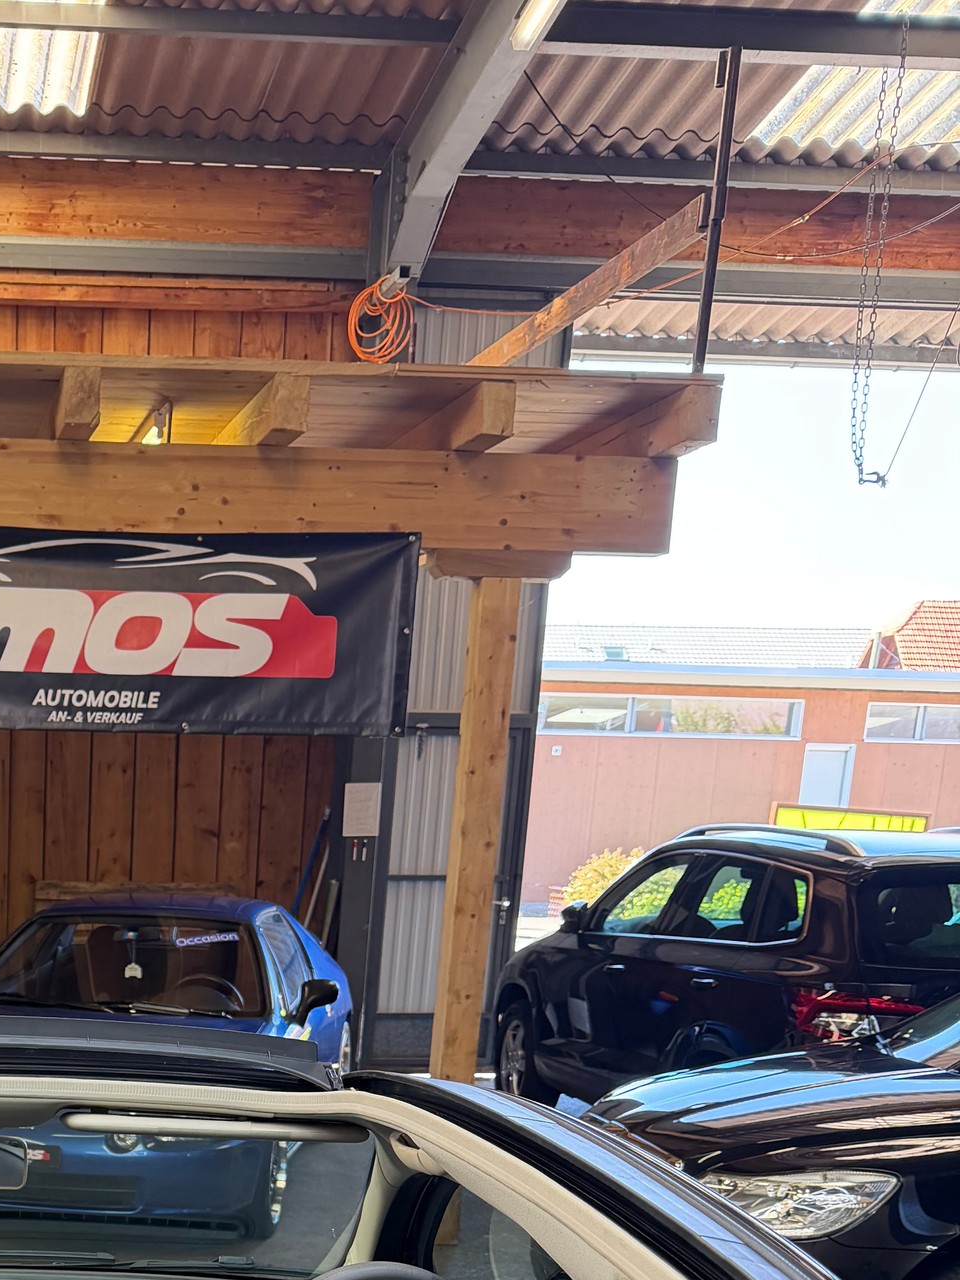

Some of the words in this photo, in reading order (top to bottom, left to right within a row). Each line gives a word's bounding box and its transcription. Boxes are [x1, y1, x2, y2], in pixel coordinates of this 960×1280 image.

[32, 688, 161, 709] AUTOMOBILE
[47, 711, 71, 723] AN-
[73, 711, 83, 723] &
[86, 712, 143, 725] VERKAUF
[175, 932, 240, 947] Occasion
